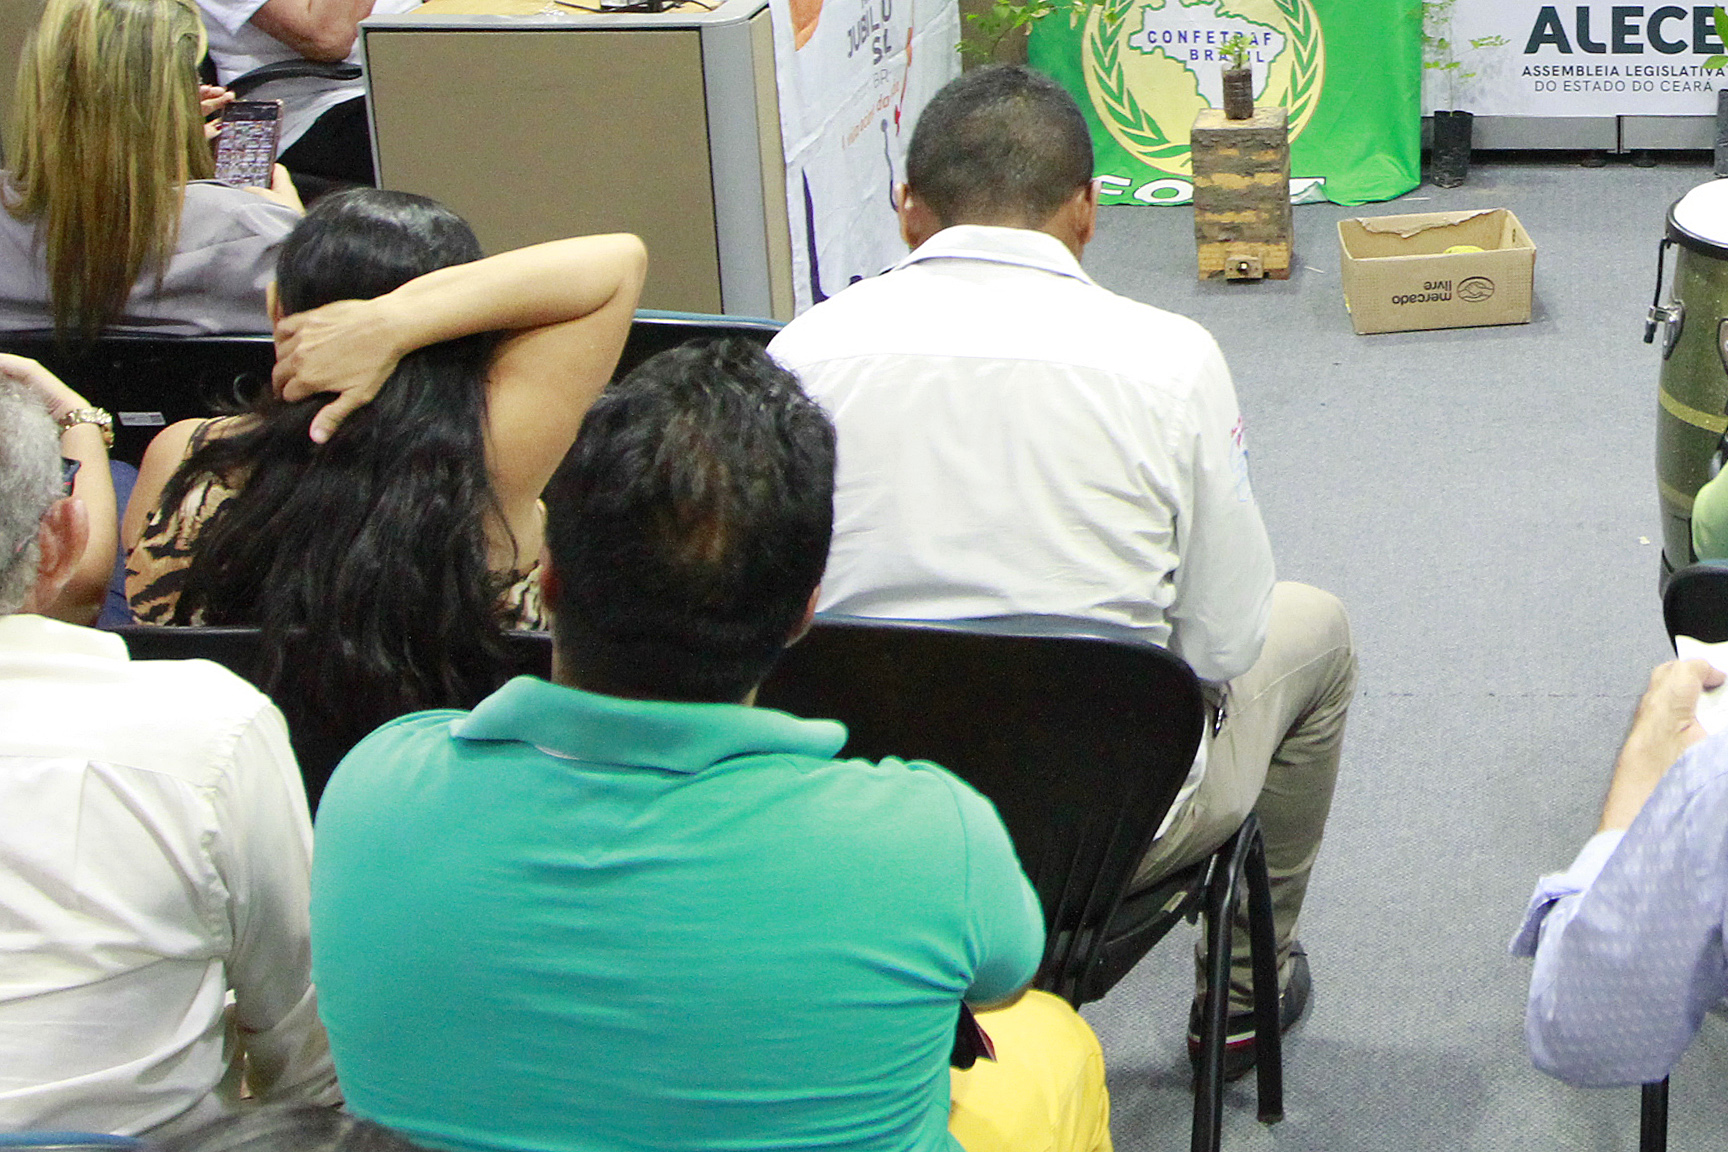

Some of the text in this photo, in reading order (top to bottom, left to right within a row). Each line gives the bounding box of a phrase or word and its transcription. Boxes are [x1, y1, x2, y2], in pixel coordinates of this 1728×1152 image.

[1523, 4, 1726, 54] ALECE
[1521, 65, 1726, 77] ASSEMBLEIA LEGISLATIVA
[1534, 78, 1713, 92] DO ESTADO DO CEARÁ
[1423, 280, 1452, 291] livre
[1391, 293, 1452, 305] mercado
